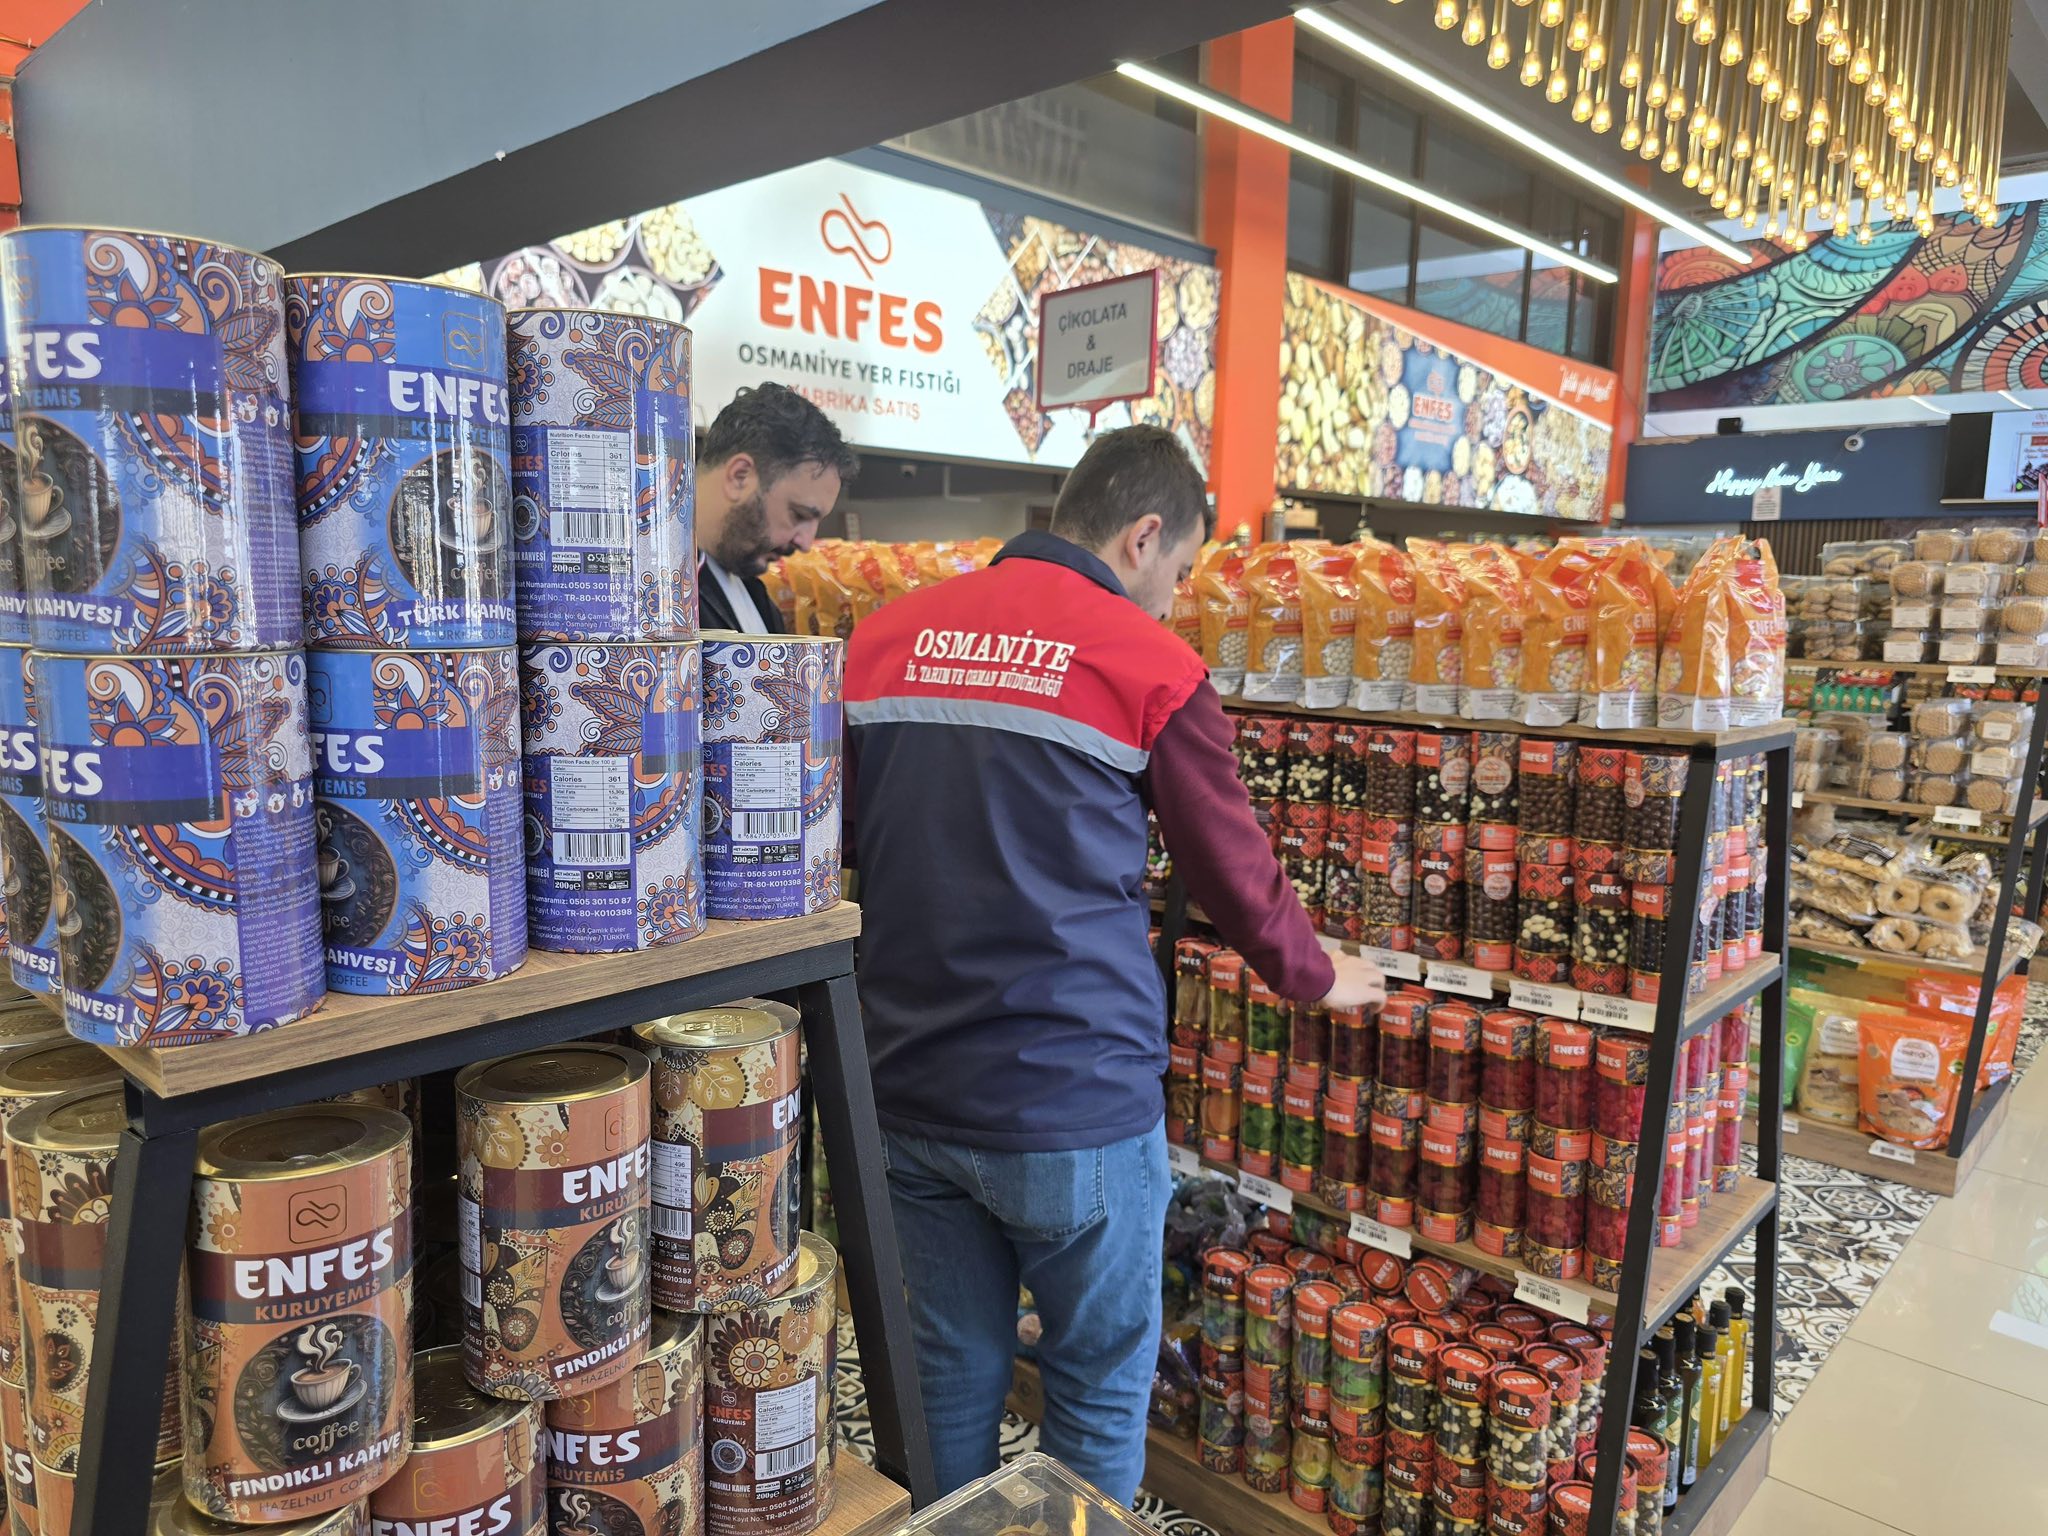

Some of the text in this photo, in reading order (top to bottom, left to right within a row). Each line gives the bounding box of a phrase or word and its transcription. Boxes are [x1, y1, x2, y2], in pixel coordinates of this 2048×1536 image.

[758, 267, 945, 354] ENFES
[1058, 302, 1128, 335] ÇİKOLATA
[1086, 335, 1097, 351] &
[16, 332, 102, 380] FES
[738, 343, 961, 396] OSMANİYE YER FISTIĞI
[1067, 354, 1113, 380] DRAJE
[388, 370, 510, 426] ENFES
[1705, 461, 1843, 496] Happy New Year
[35, 597, 122, 627] KAHVESİ
[397, 604, 460, 628] TÜRK
[1330, 608, 1355, 621] ENF
[914, 628, 1076, 672] OSMANİYE
[904, 659, 916, 682] İL
[919, 665, 951, 684] TARIM
[950, 668, 966, 686] VE
[965, 669, 998, 687] ORMAN
[312, 733, 385, 774] FES
[40, 747, 103, 796] FES
[553, 775, 582, 783] Calories
[316, 780, 367, 797] YEMİŞ
[1421, 859, 1449, 871] ENFES
[743, 879, 801, 888] TR-80-K010398
[1590, 884, 1622, 896] ENFES
[566, 908, 632, 917] TR-80-K010398
[331, 974, 368, 987] COFFEE
[1554, 1044, 1586, 1056] ENFES
[1423, 1140, 1453, 1153] ENFES
[1487, 1148, 1518, 1161] ENFES
[1530, 1167, 1557, 1184] ENFES
[235, 1226, 393, 1299] ENFES
[661, 1263, 672, 1272] 301
[672, 1266, 682, 1274] 50
[1209, 1273, 1233, 1287] ENFES
[1297, 1312, 1323, 1325] ENFES
[1479, 1334, 1515, 1347] ENFES
[554, 1332, 630, 1379] FINDIKLI
[1394, 1354, 1422, 1369] ENFES
[1446, 1376, 1477, 1391] ENFES
[709, 1405, 751, 1420] ENFES
[758, 1405, 784, 1413] Calories
[1498, 1398, 1531, 1417] ENFES
[1302, 1414, 1328, 1429] ENFES
[292, 1420, 360, 1455] coffee
[229, 1431, 402, 1498] FINDIKLI KAHVE
[1388, 1464, 1416, 1481] ENFES
[732, 1484, 751, 1493] KAHVE
[259, 1489, 334, 1512] HAZELNUT
[769, 1502, 787, 1511] 0505
[788, 1497, 799, 1506] 301
[1492, 1513, 1522, 1533] ENFES
